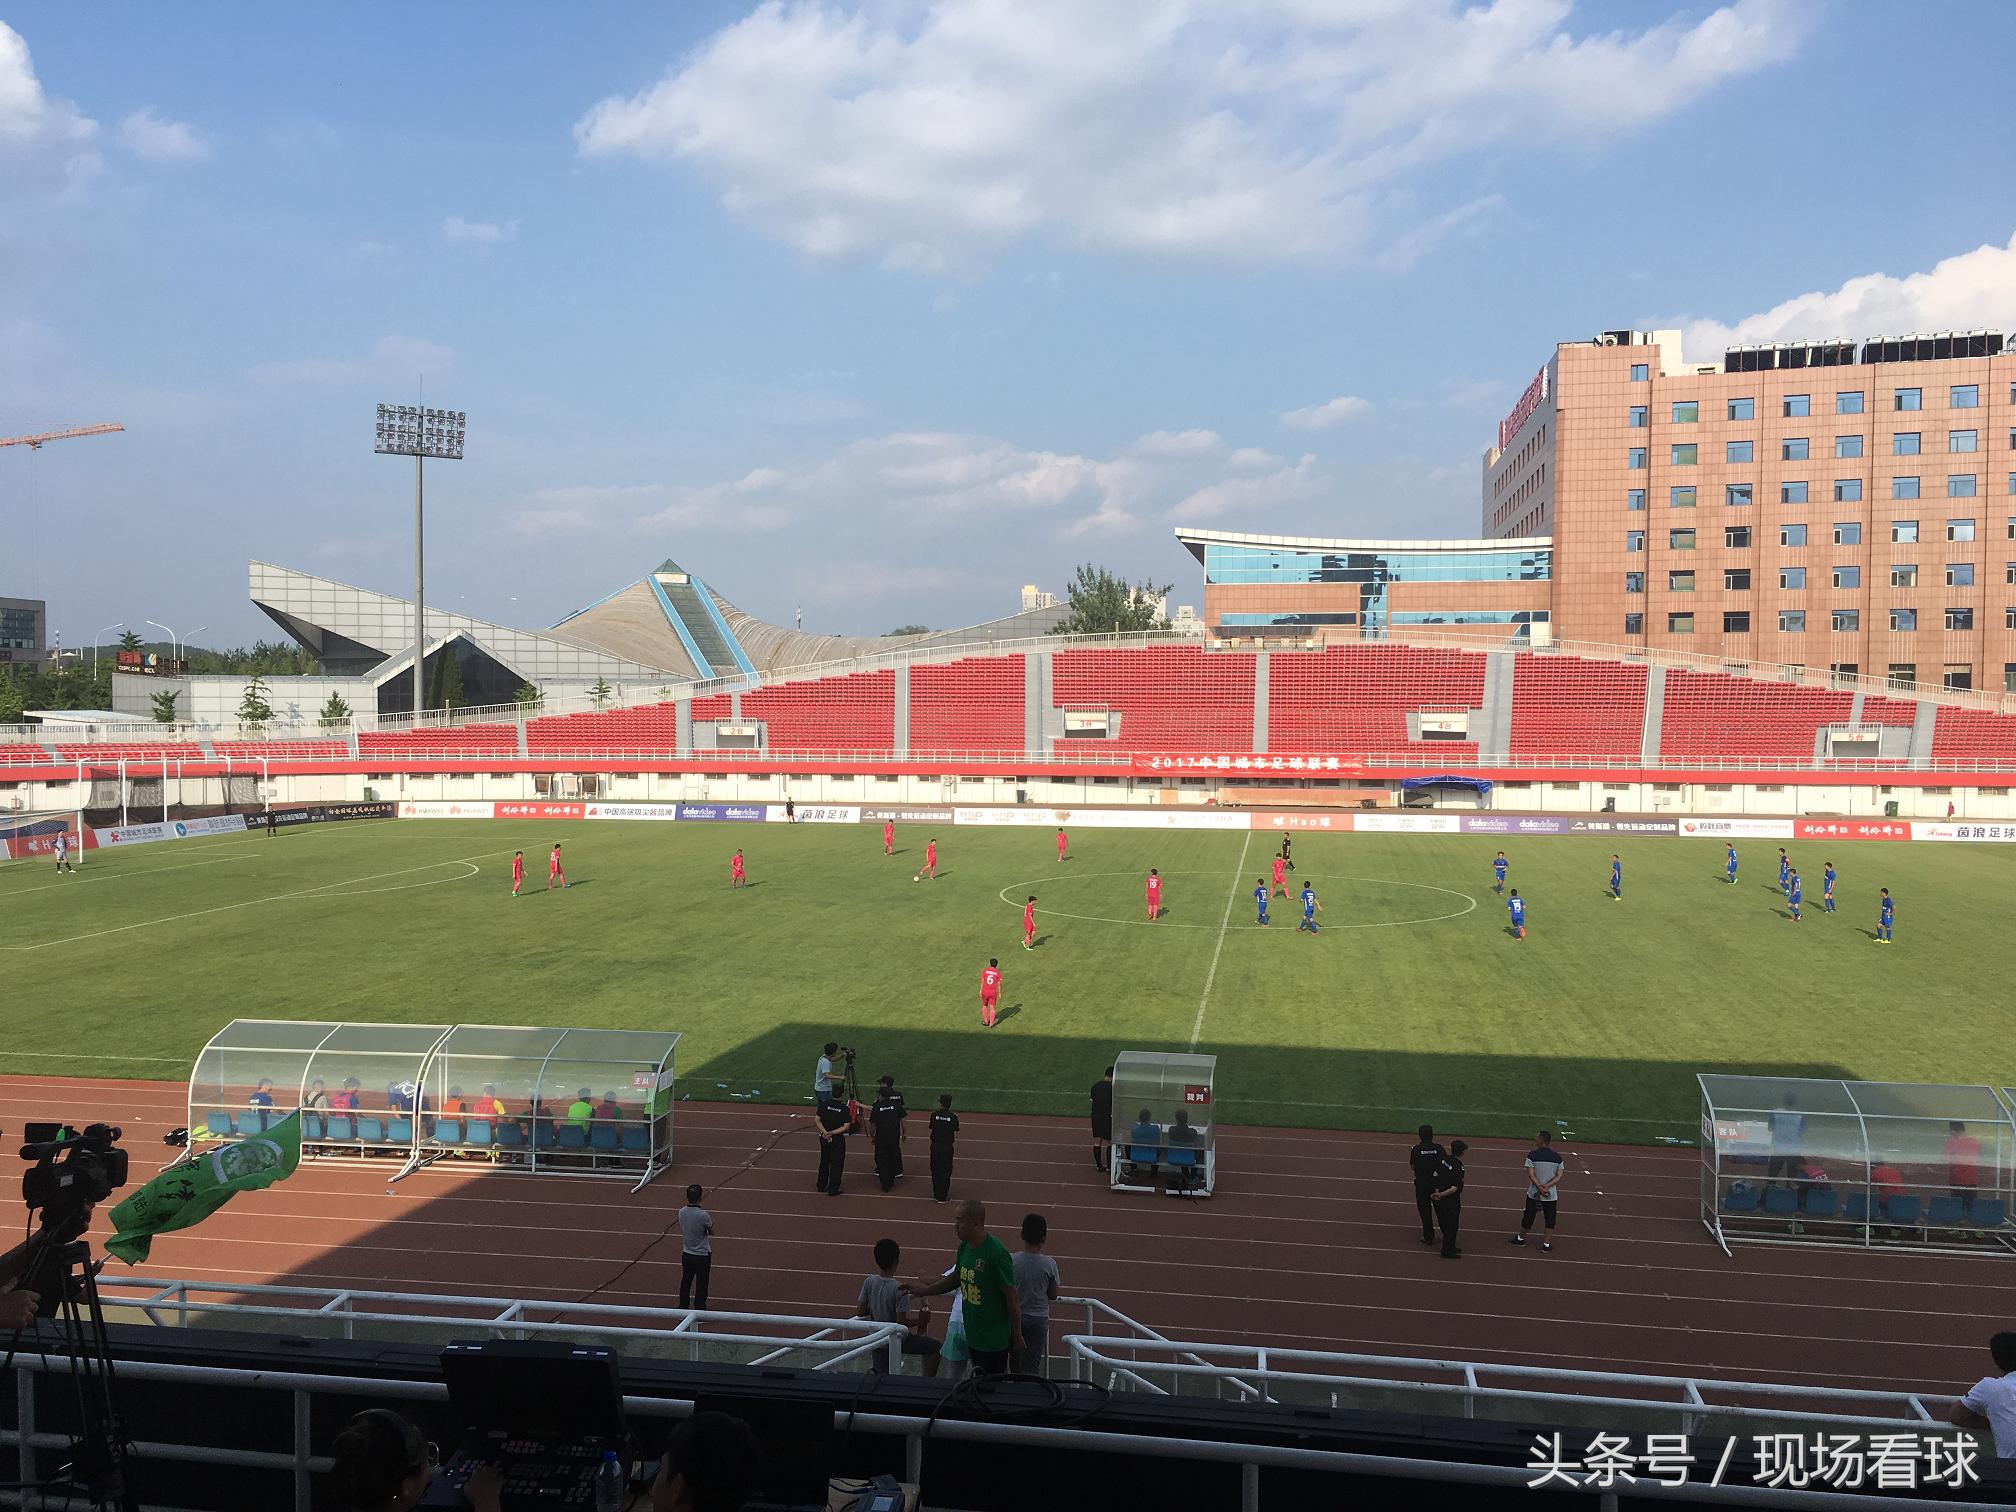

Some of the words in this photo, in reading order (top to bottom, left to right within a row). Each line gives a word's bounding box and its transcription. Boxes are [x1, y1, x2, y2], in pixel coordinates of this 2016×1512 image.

[1438, 722, 1452, 730] 4台
[1848, 733, 1864, 741] 5台
[1152, 756, 1340, 770] 2017中国城市足球联赛
[682, 807, 717, 815] datavideo
[725, 807, 760, 815] datavideo
[803, 809, 849, 819] 茵浪足球
[1468, 818, 1508, 828] datavideo
[1519, 819, 1560, 828] datavideo
[1957, 826, 2015, 838] 茵浪足球
[987, 975, 994, 985] 6
